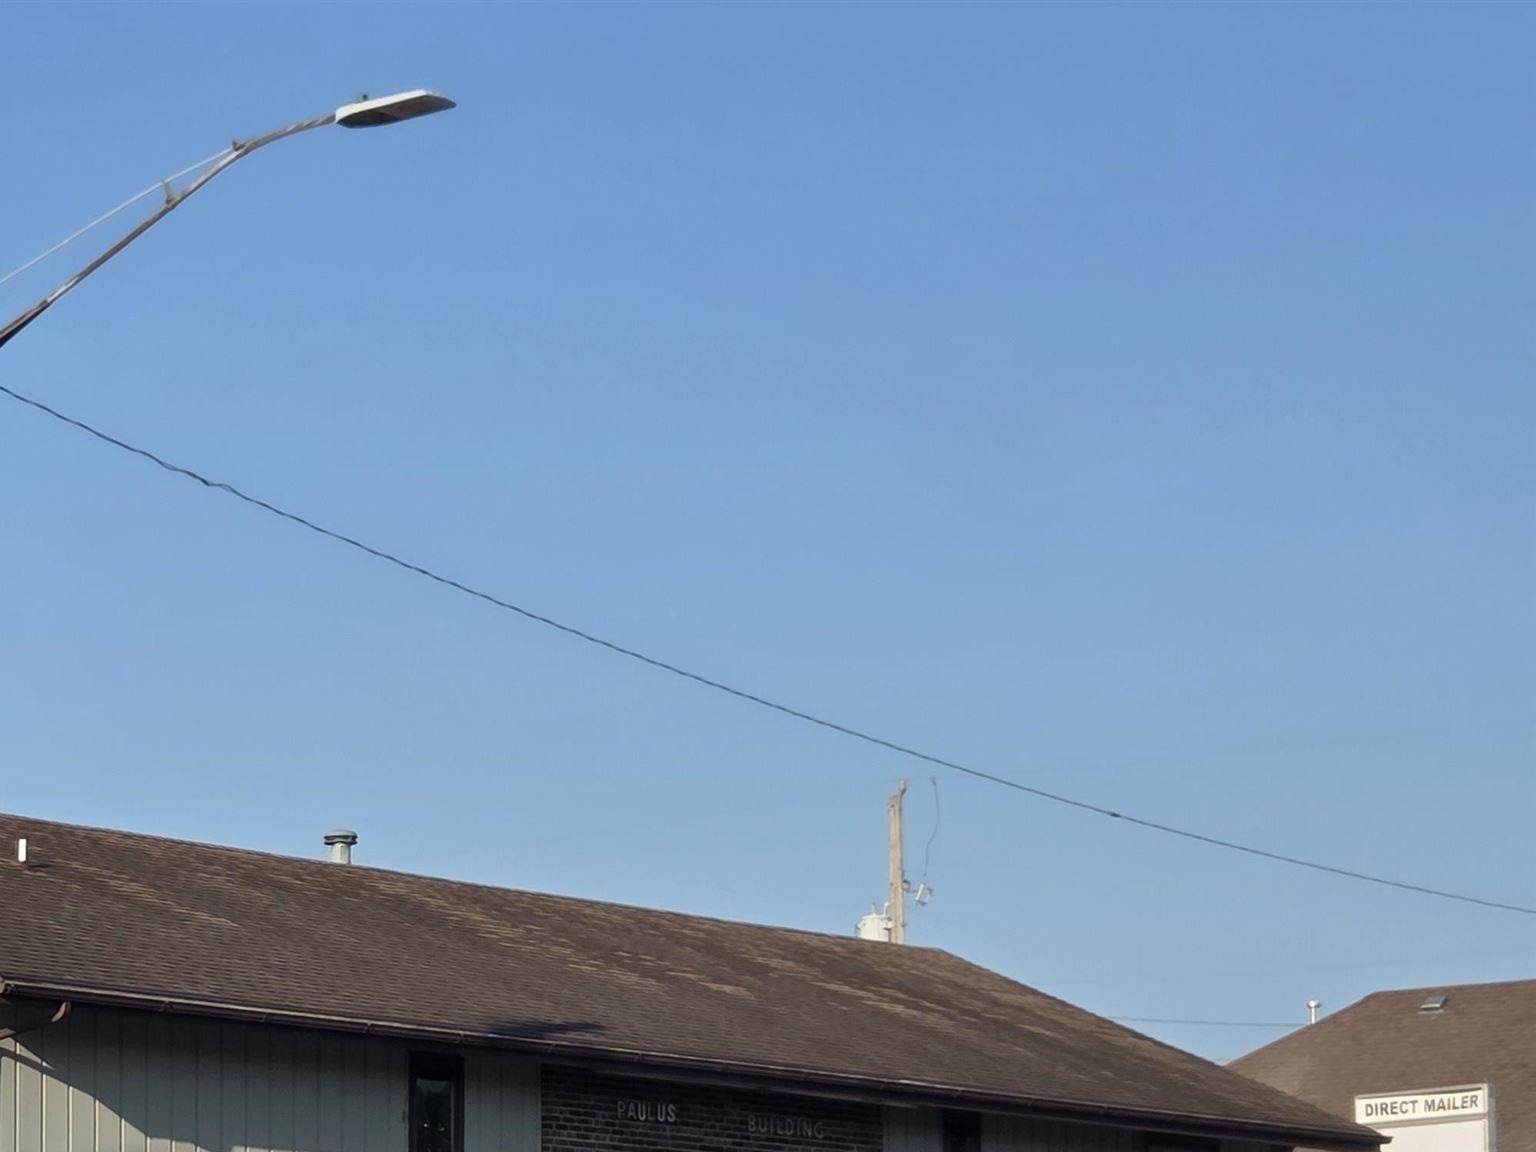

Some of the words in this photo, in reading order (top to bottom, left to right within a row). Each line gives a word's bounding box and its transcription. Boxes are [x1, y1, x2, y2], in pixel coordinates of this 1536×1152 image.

[617, 1101, 676, 1122] PAULUS
[747, 1115, 824, 1138] BUILDING
[1366, 1101, 1418, 1117] DIRECT
[1424, 1095, 1478, 1113] MAILER
